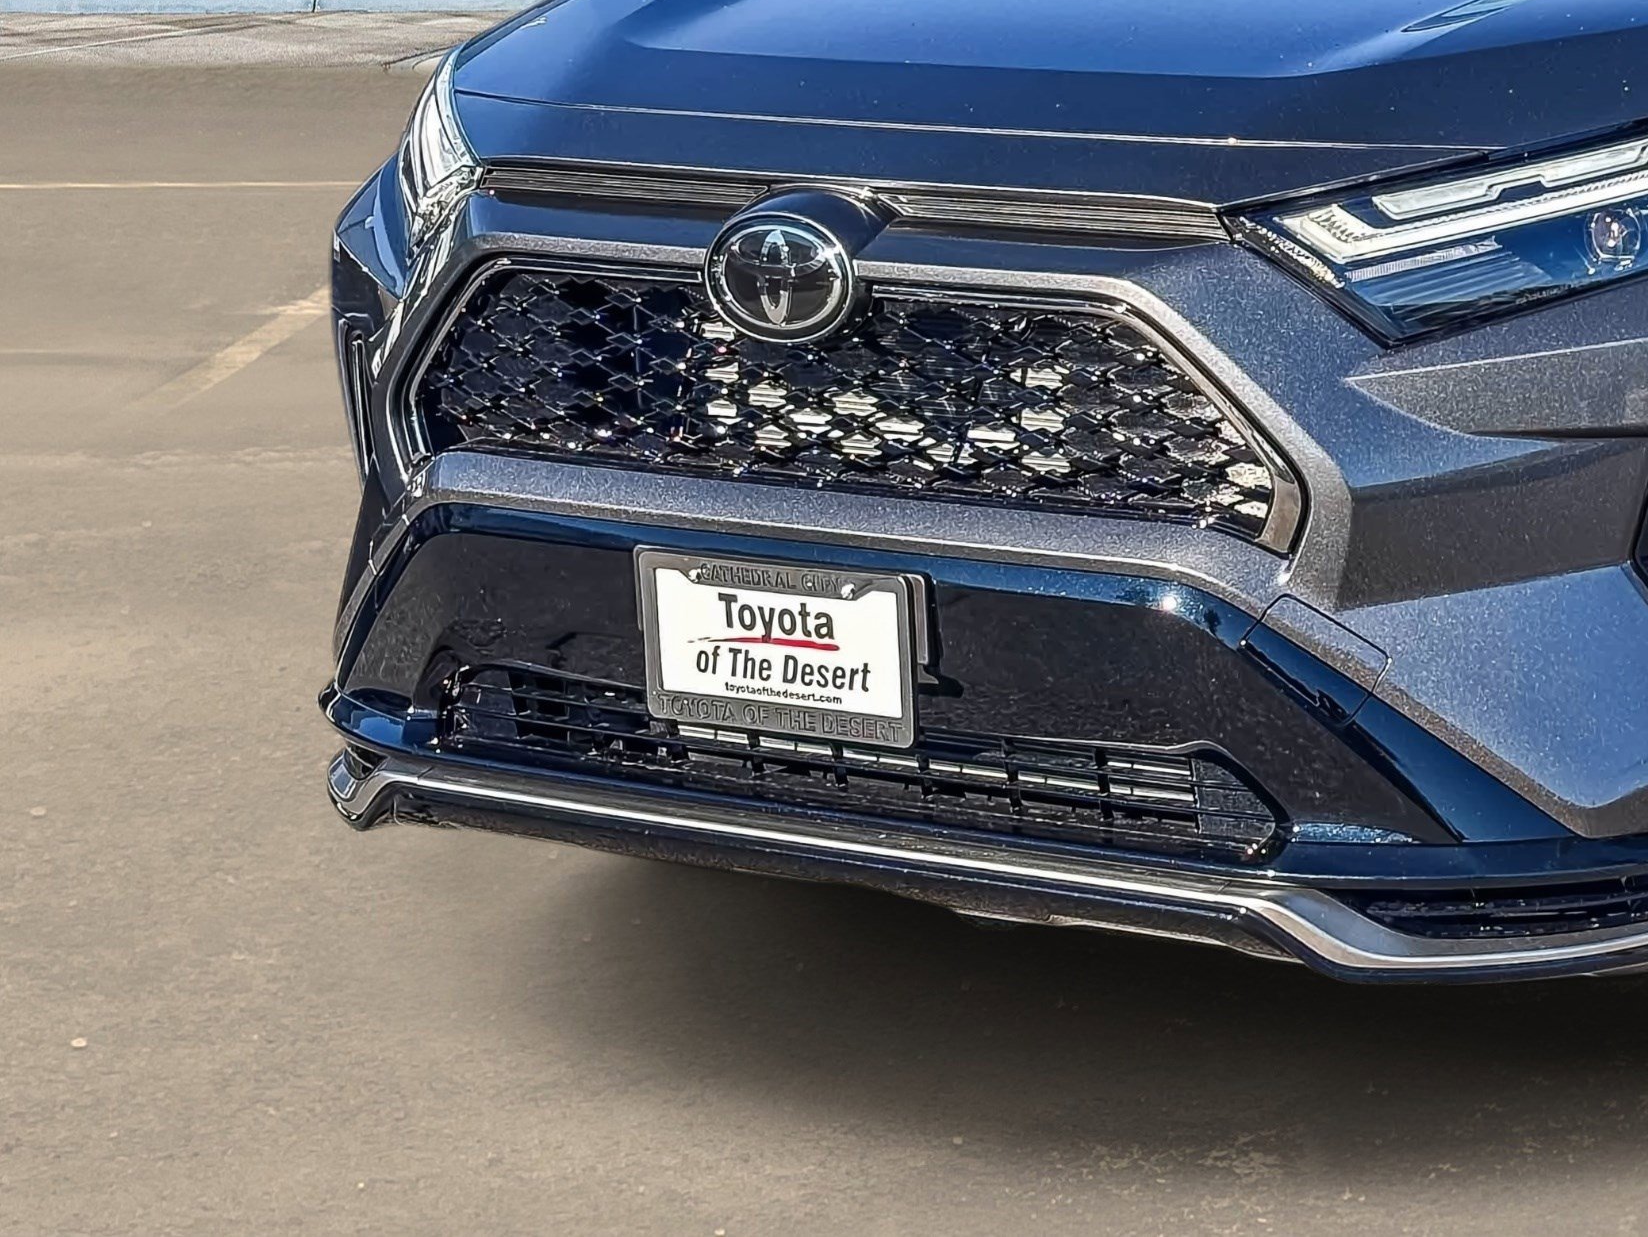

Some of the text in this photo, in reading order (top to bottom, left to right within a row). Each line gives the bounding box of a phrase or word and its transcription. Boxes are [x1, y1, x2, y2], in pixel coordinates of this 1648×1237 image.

[700, 562, 797, 590] CATHEDRAL
[718, 592, 835, 642] Toyota
[696, 646, 871, 693] of The Desert
[724, 681, 843, 706] toyotaofthedesert.com
[657, 693, 904, 743] TOYOTA OF THE DESERT
